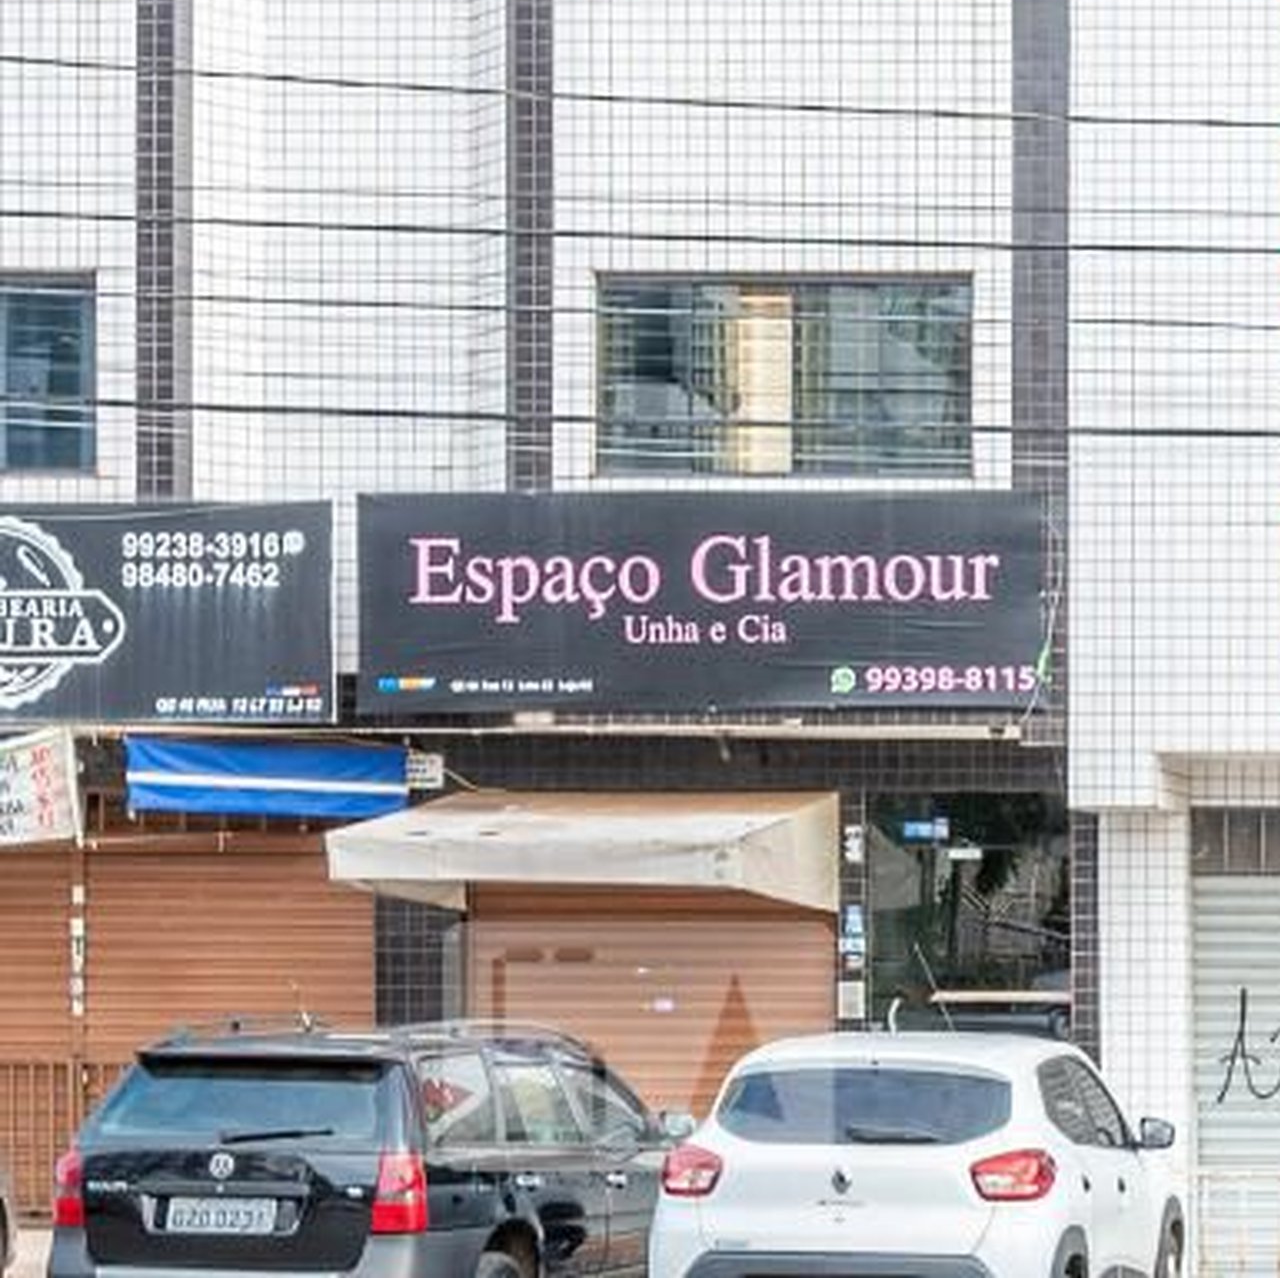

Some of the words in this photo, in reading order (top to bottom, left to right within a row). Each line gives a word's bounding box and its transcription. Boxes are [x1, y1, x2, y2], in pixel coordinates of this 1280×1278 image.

[121, 562, 280, 588] 98480-7462
[408, 537, 660, 623] Espaço
[690, 534, 1000, 603] Glamour
[623, 615, 700, 644] Unha
[709, 623, 727, 644] e
[737, 615, 787, 644] Cia
[865, 666, 1036, 692] 99398-8115
